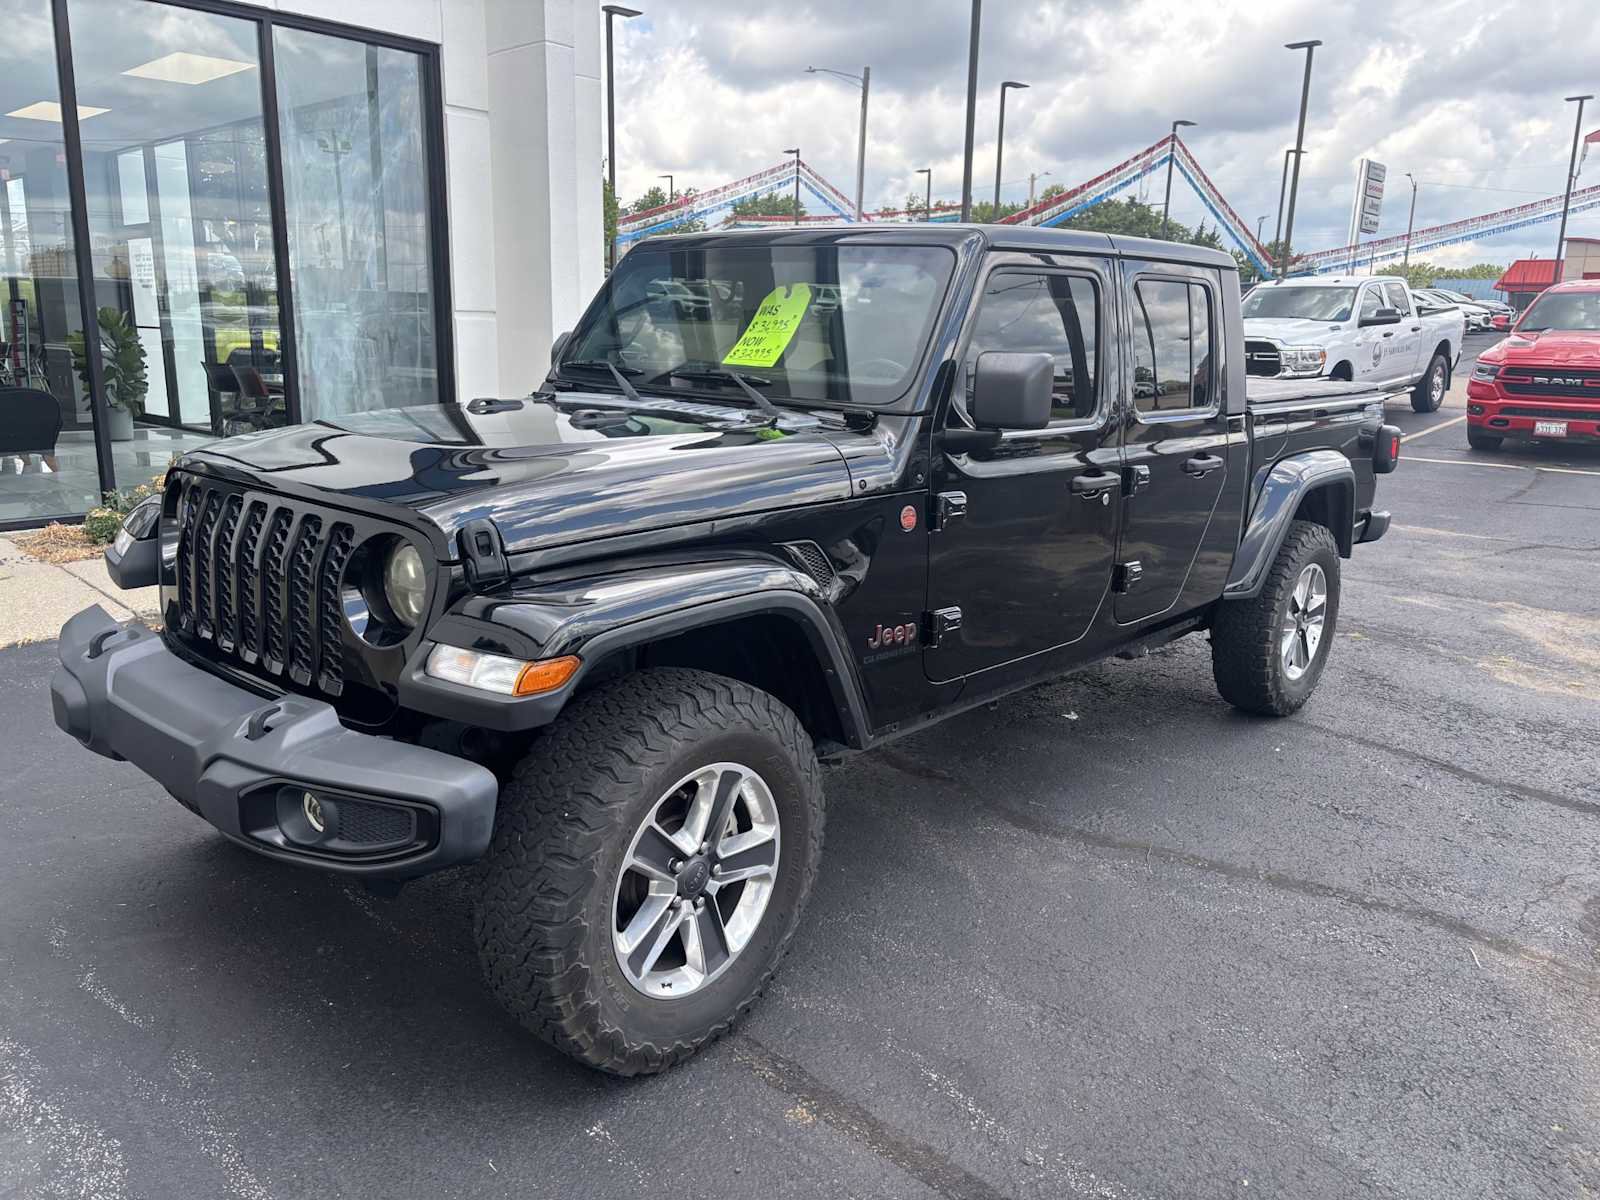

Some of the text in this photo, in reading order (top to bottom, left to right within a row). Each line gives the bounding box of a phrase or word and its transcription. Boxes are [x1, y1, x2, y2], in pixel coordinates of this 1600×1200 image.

[759, 304, 781, 317] WAS
[740, 336, 767, 348] NOW
[1533, 377, 1582, 386] RAM
[868, 622, 917, 649] Jeep
